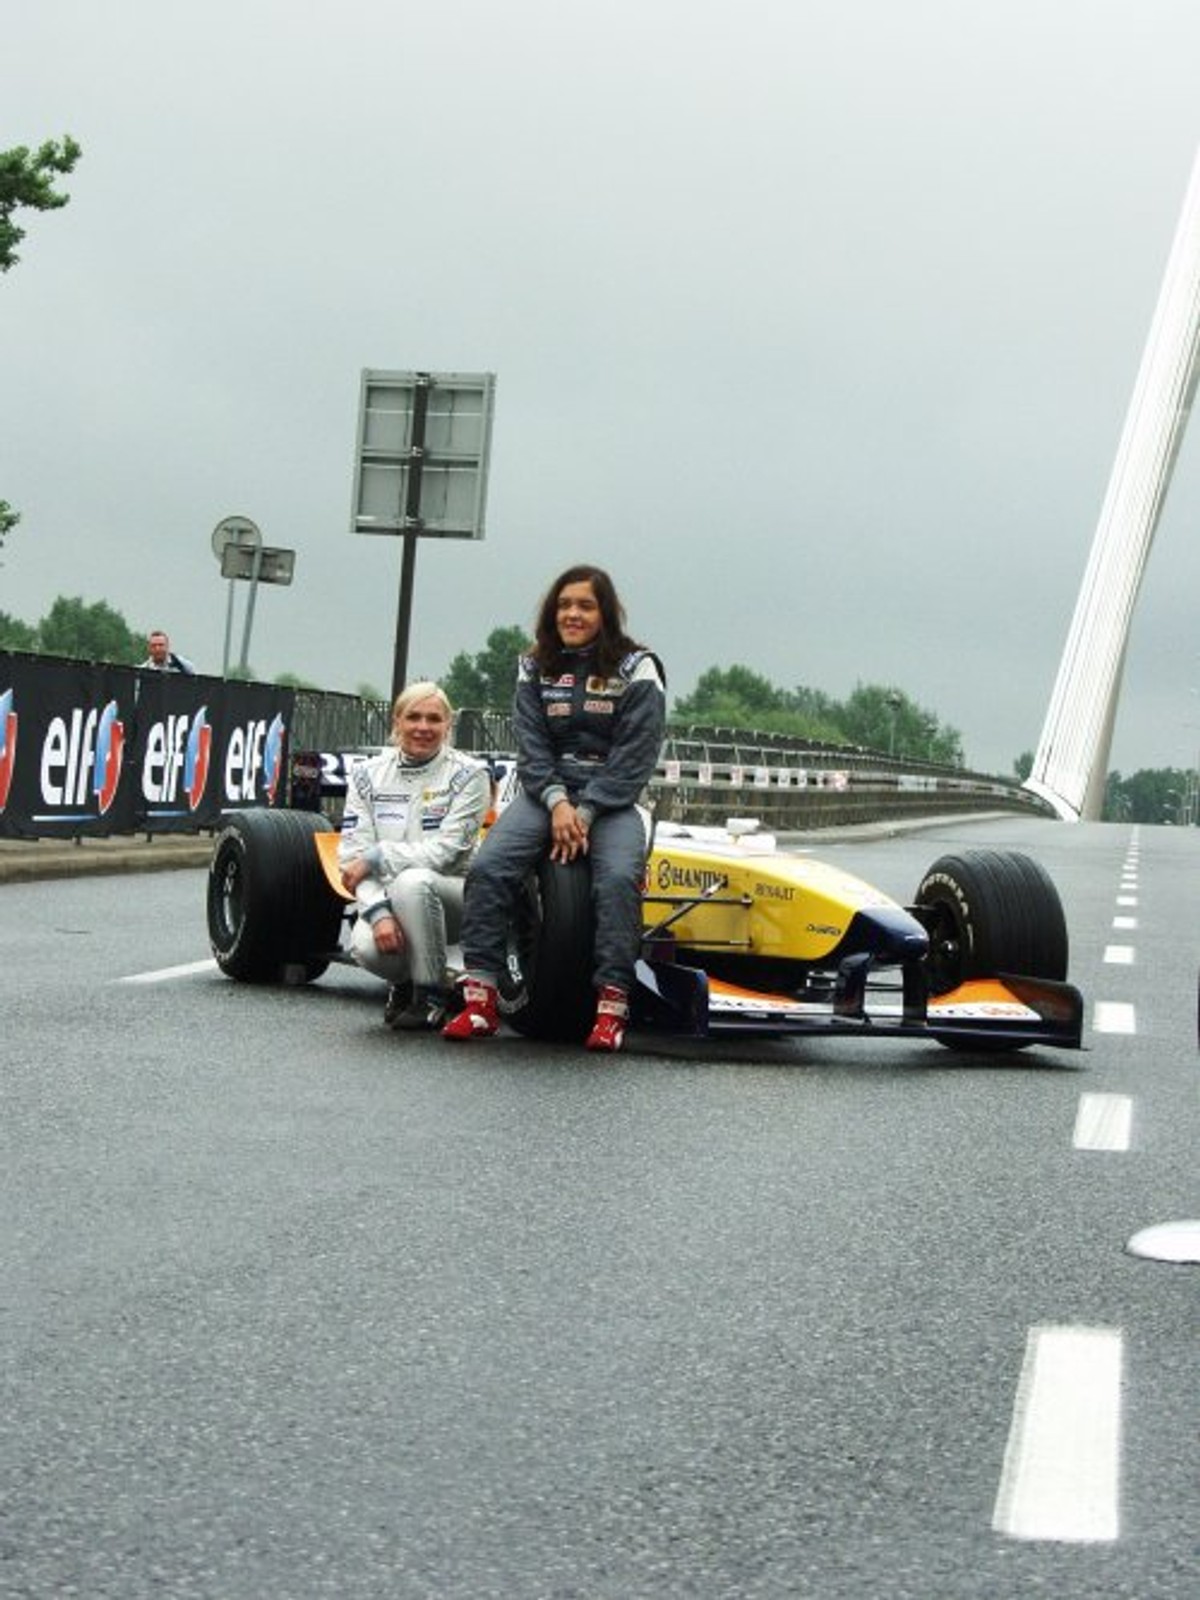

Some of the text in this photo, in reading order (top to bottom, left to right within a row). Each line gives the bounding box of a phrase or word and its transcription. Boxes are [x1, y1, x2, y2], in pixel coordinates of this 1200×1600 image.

[40, 707, 97, 805] elf
[142, 714, 189, 802] elf
[225, 719, 266, 800] elf
